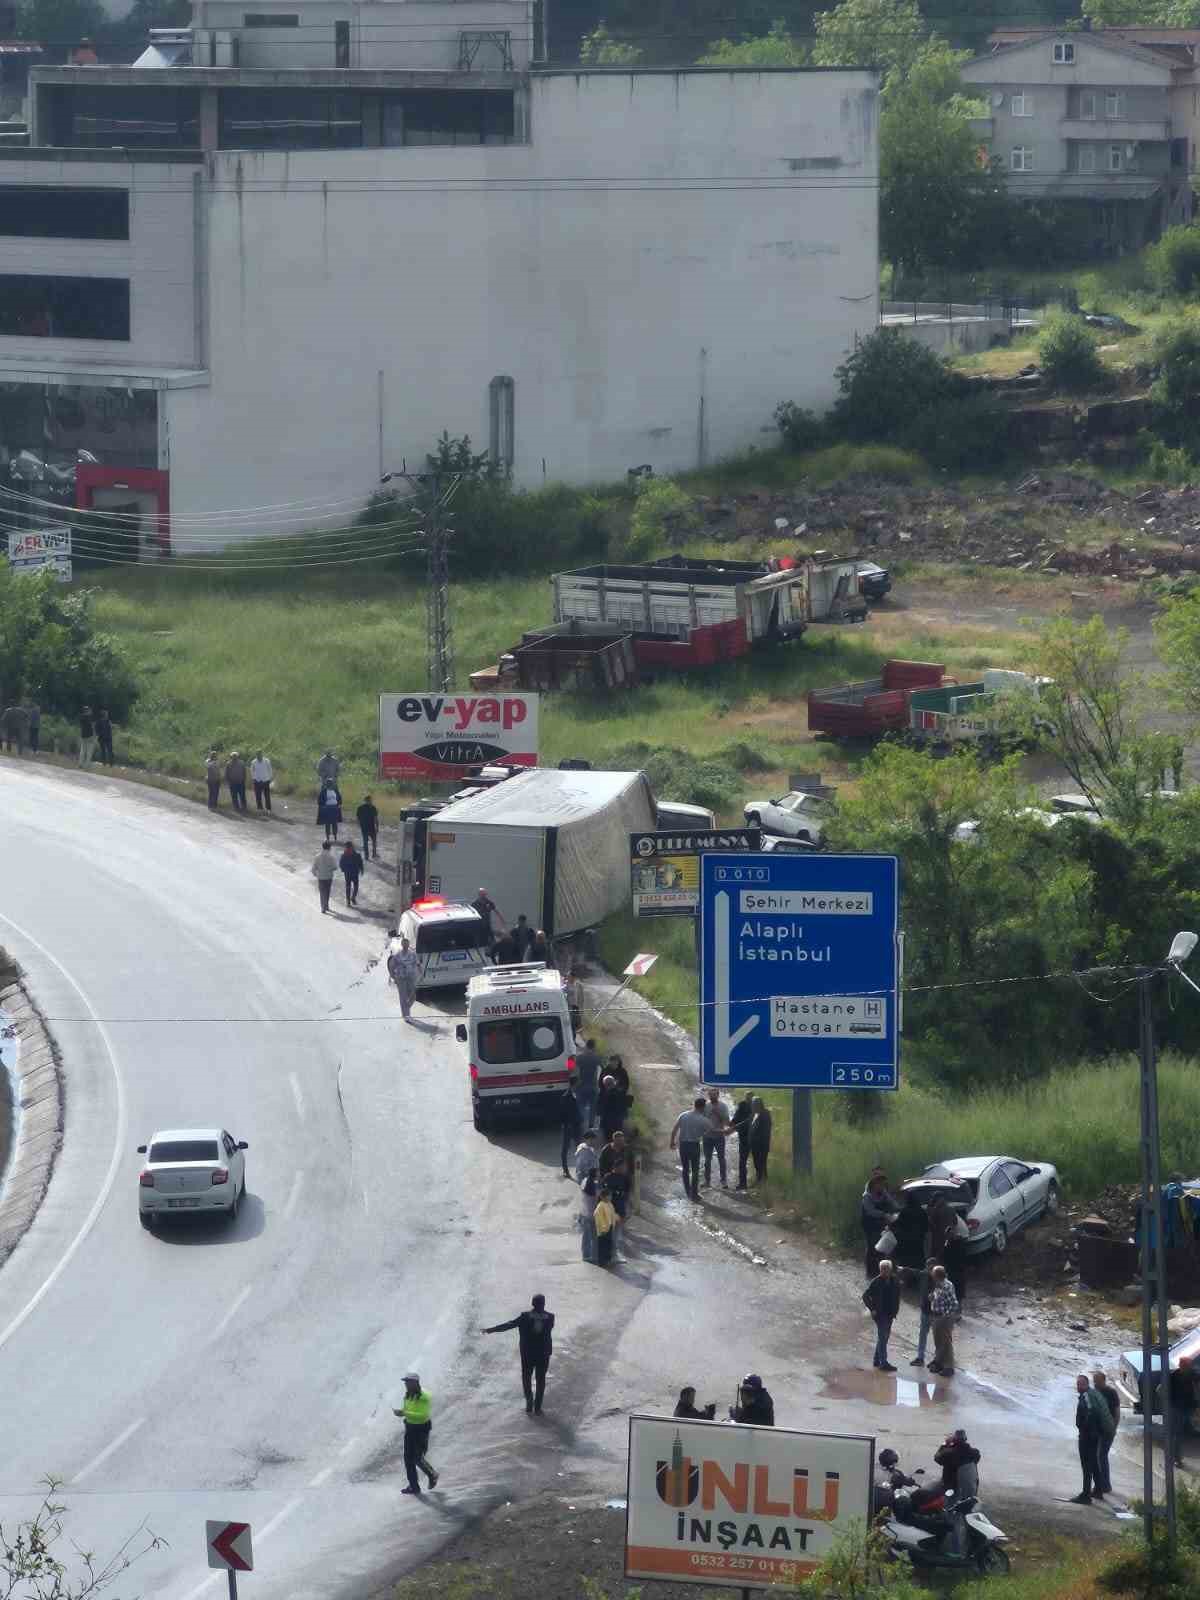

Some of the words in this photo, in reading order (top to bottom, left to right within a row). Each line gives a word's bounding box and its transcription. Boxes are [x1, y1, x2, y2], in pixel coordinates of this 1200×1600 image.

[397, 697, 527, 730] ev-yap
[437, 745, 484, 760] VitrA
[719, 869, 727, 880] D
[734, 869, 765, 880] 010
[745, 895, 791, 909] Şehir
[802, 896, 869, 910] Merkezi
[740, 922, 803, 941] Alaplı
[739, 941, 831, 962] İstanbul
[484, 1001, 550, 1015] AMBULANS
[776, 1001, 856, 1014] Hastane
[867, 1003, 878, 1015] H
[776, 1019, 841, 1035] Otogar
[836, 1069, 874, 1081] 250
[677, 1511, 814, 1550] İNŞAAT
[691, 1554, 725, 1568] 0532
